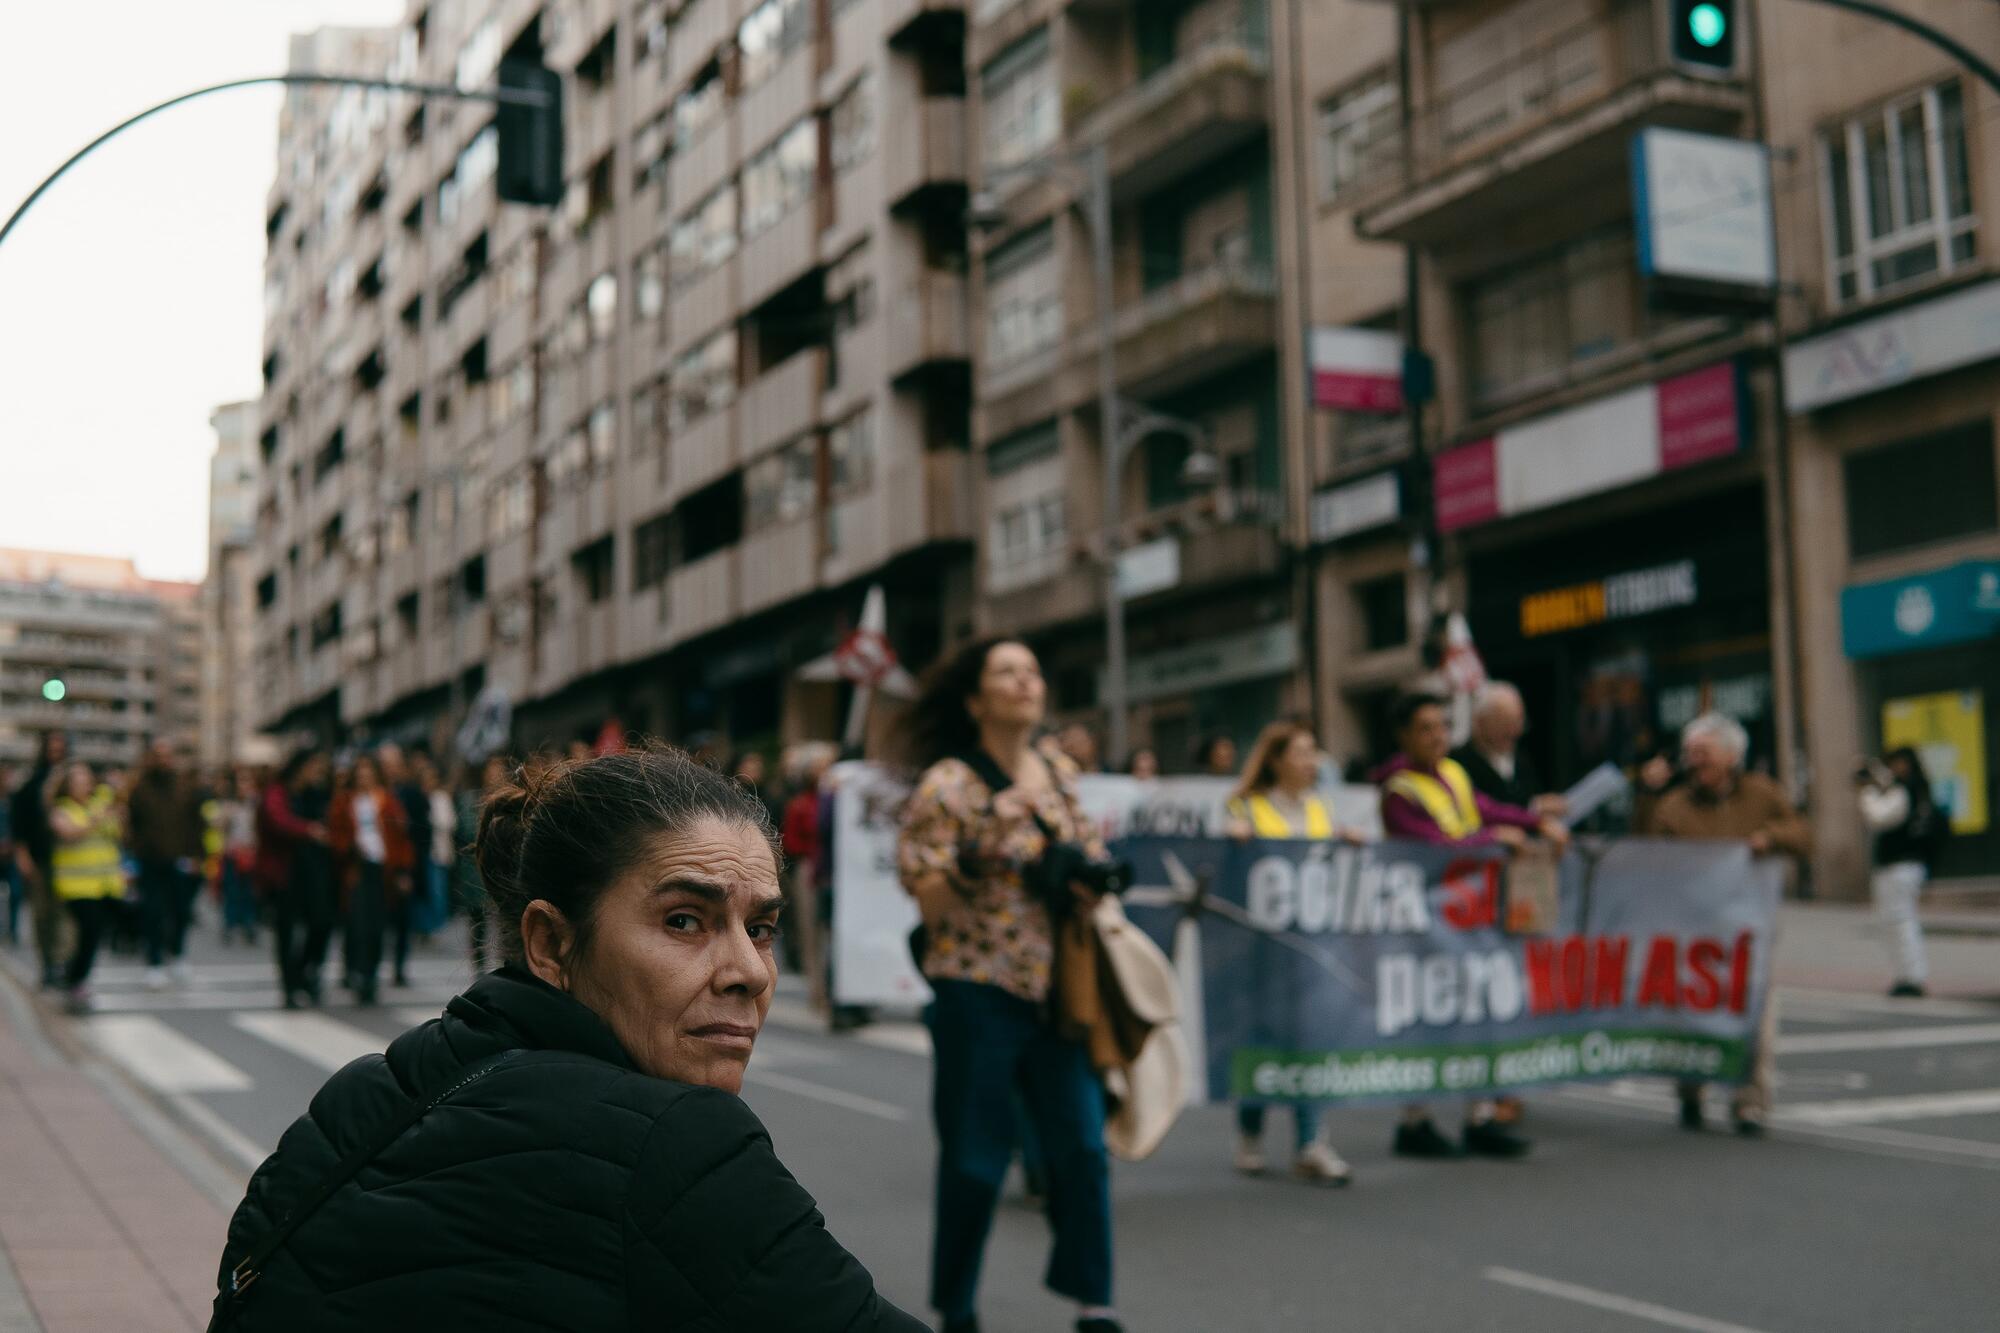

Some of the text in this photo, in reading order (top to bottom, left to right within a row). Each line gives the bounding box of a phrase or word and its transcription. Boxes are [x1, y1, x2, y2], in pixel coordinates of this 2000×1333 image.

[1376, 929, 1752, 1036] pero NON ASÍ
[1441, 1055, 1489, 1089] en
